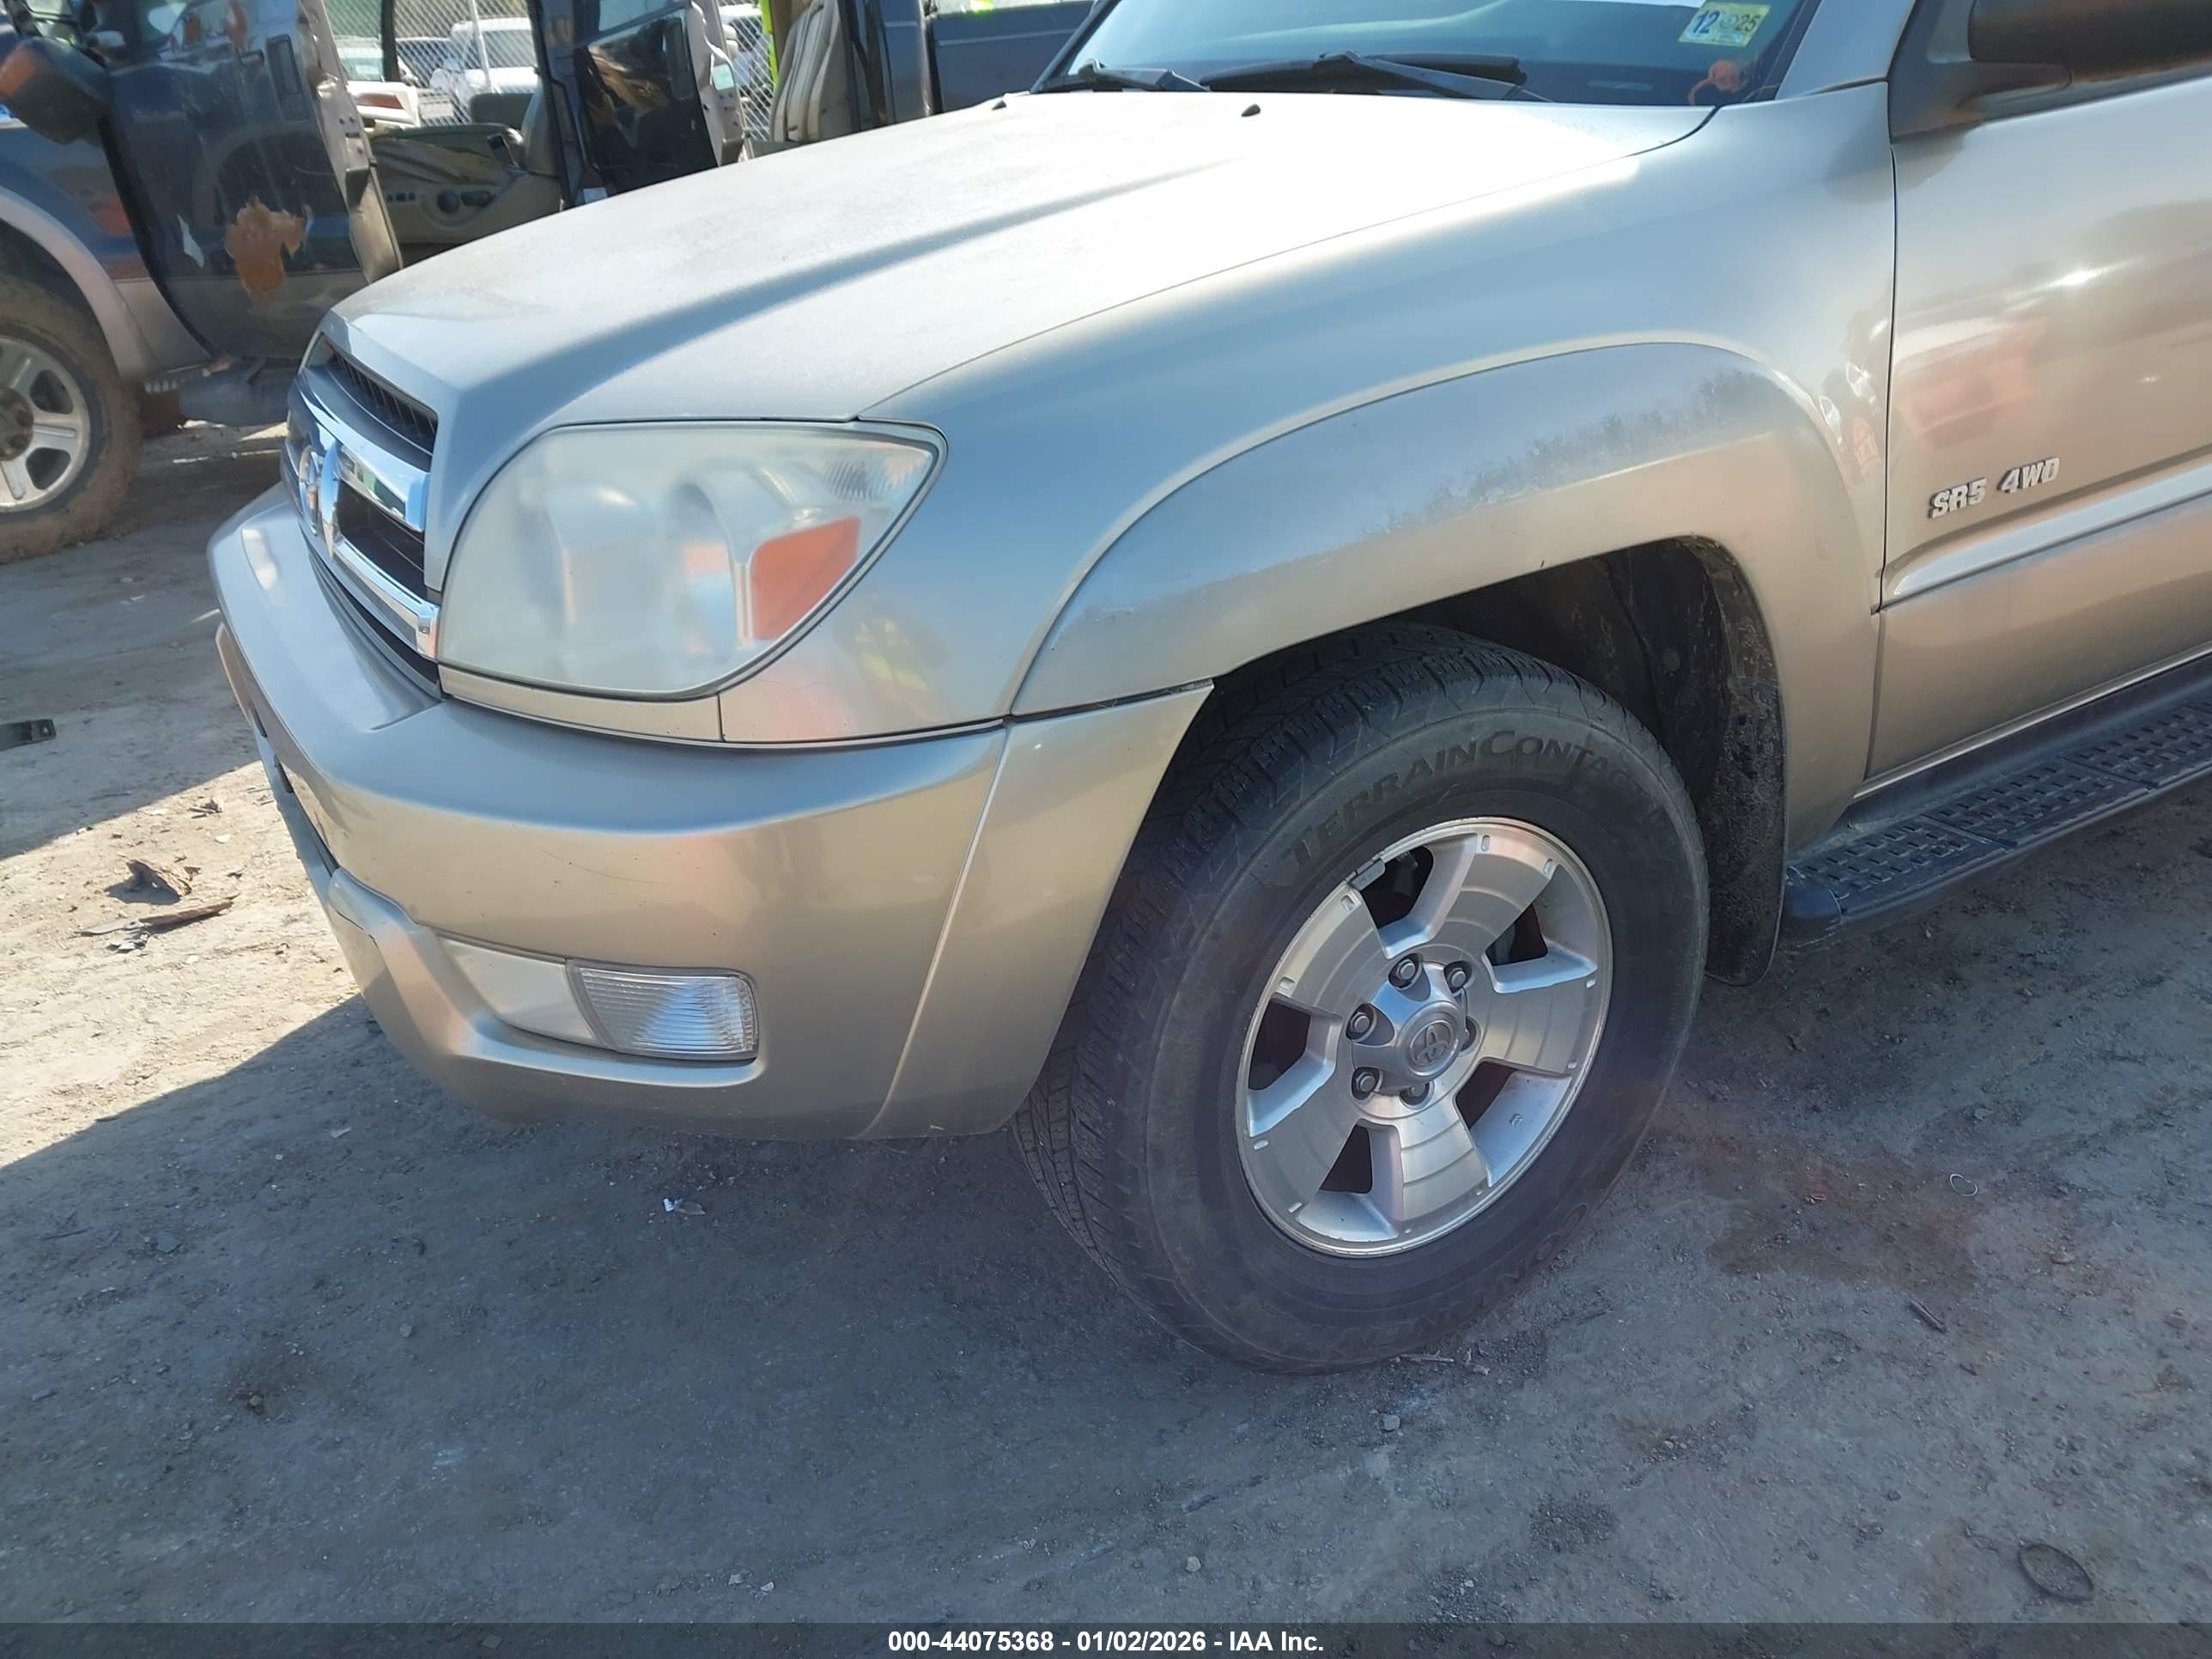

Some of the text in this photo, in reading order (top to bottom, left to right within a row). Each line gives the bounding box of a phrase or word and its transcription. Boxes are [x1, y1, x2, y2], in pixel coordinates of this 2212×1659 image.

[1692, 10, 1760, 33] 12 25
[1928, 457, 2060, 519] SR5 4WD
